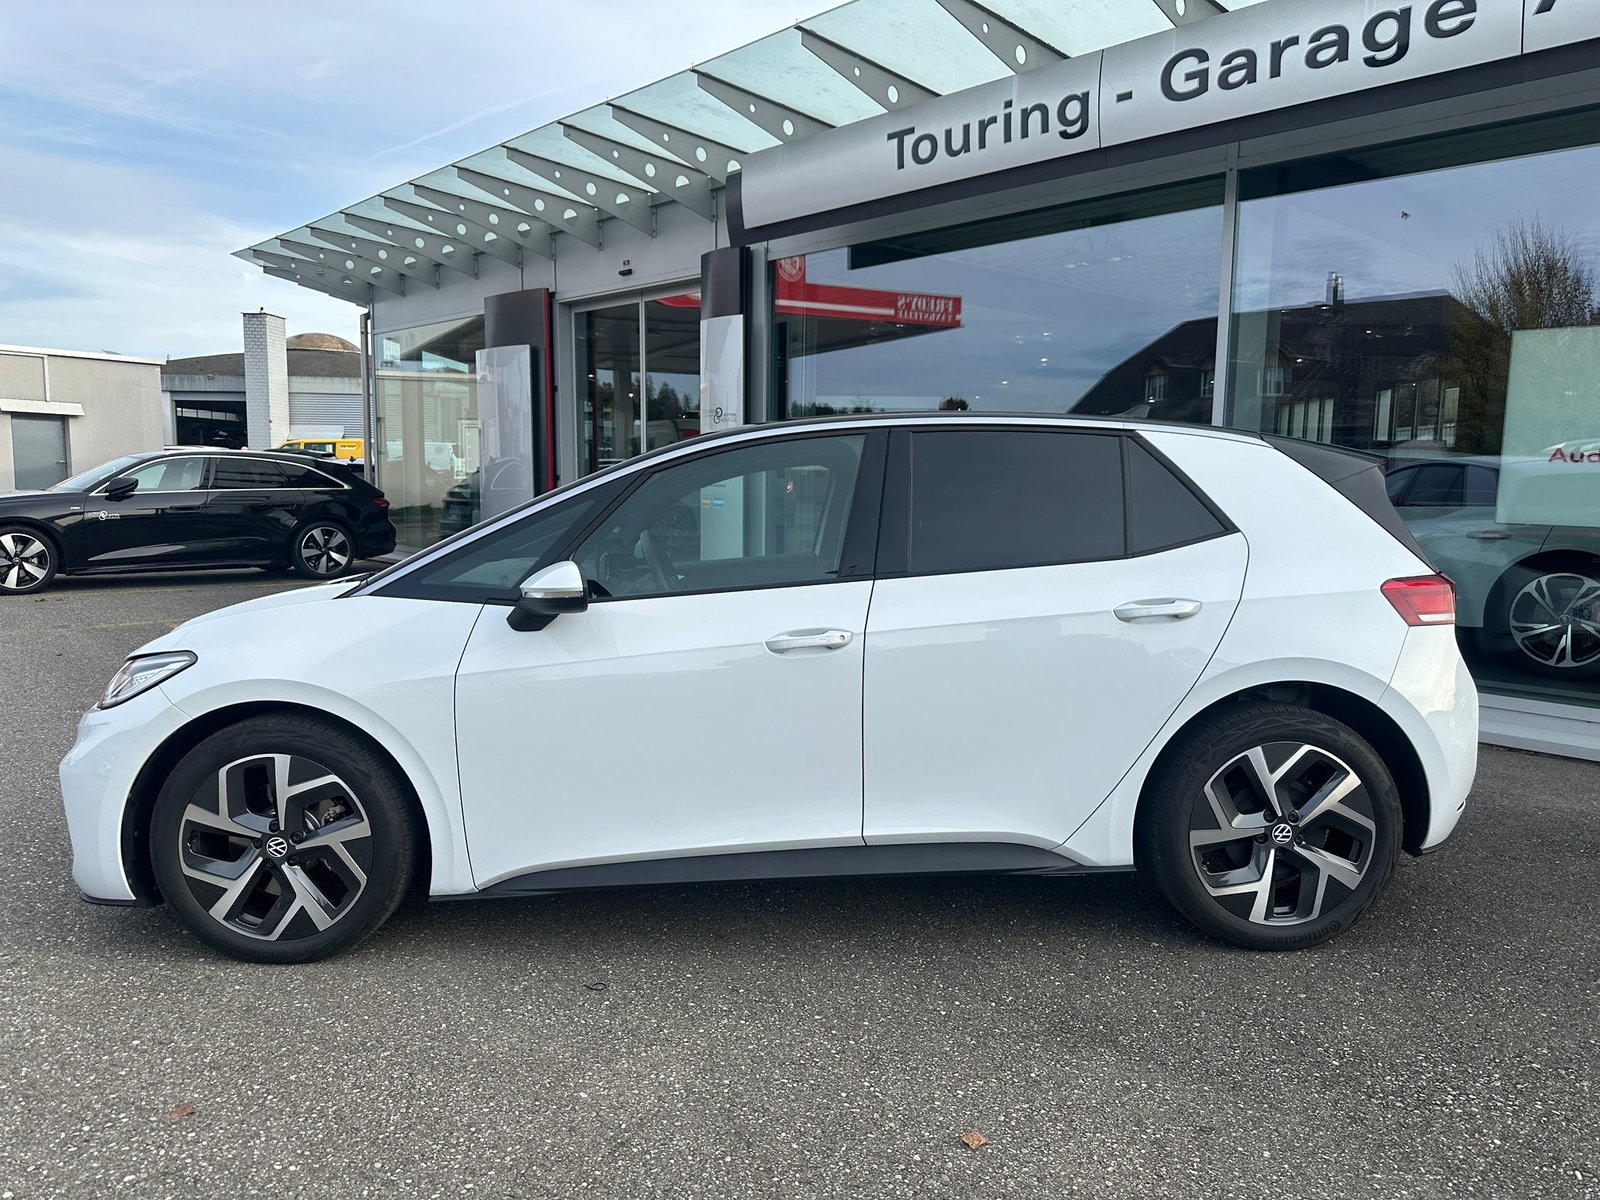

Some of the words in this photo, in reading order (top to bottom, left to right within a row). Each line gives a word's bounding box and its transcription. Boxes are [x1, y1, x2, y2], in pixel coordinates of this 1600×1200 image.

[887, 90, 1090, 170] Touring
[1116, 90, 1133, 103] -
[1160, 0, 1477, 102] Garage
